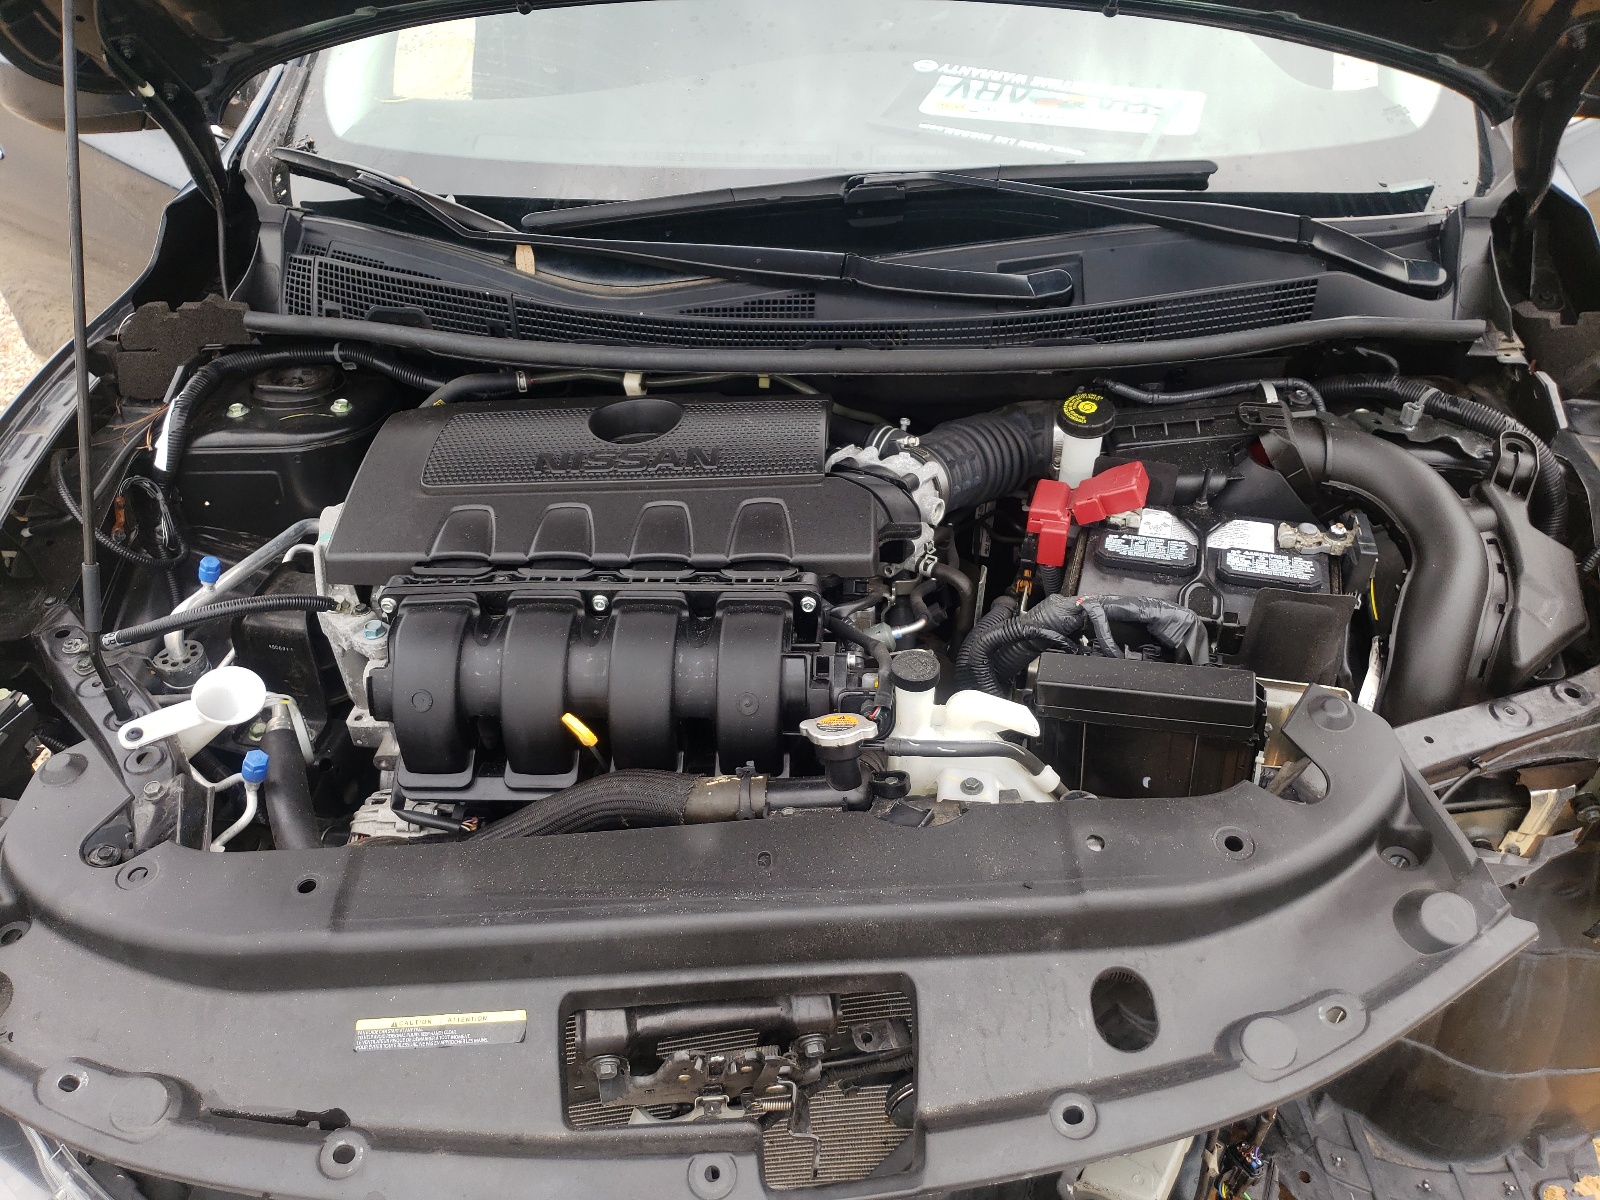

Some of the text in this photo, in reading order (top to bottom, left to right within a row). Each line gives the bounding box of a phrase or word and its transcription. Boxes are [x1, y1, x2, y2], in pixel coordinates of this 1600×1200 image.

[937, 63, 1028, 84] WARRANTY
[534, 447, 720, 473] NISSAN
[399, 1019, 432, 1027] CAUTION
[447, 1015, 488, 1023] ATTENTION
